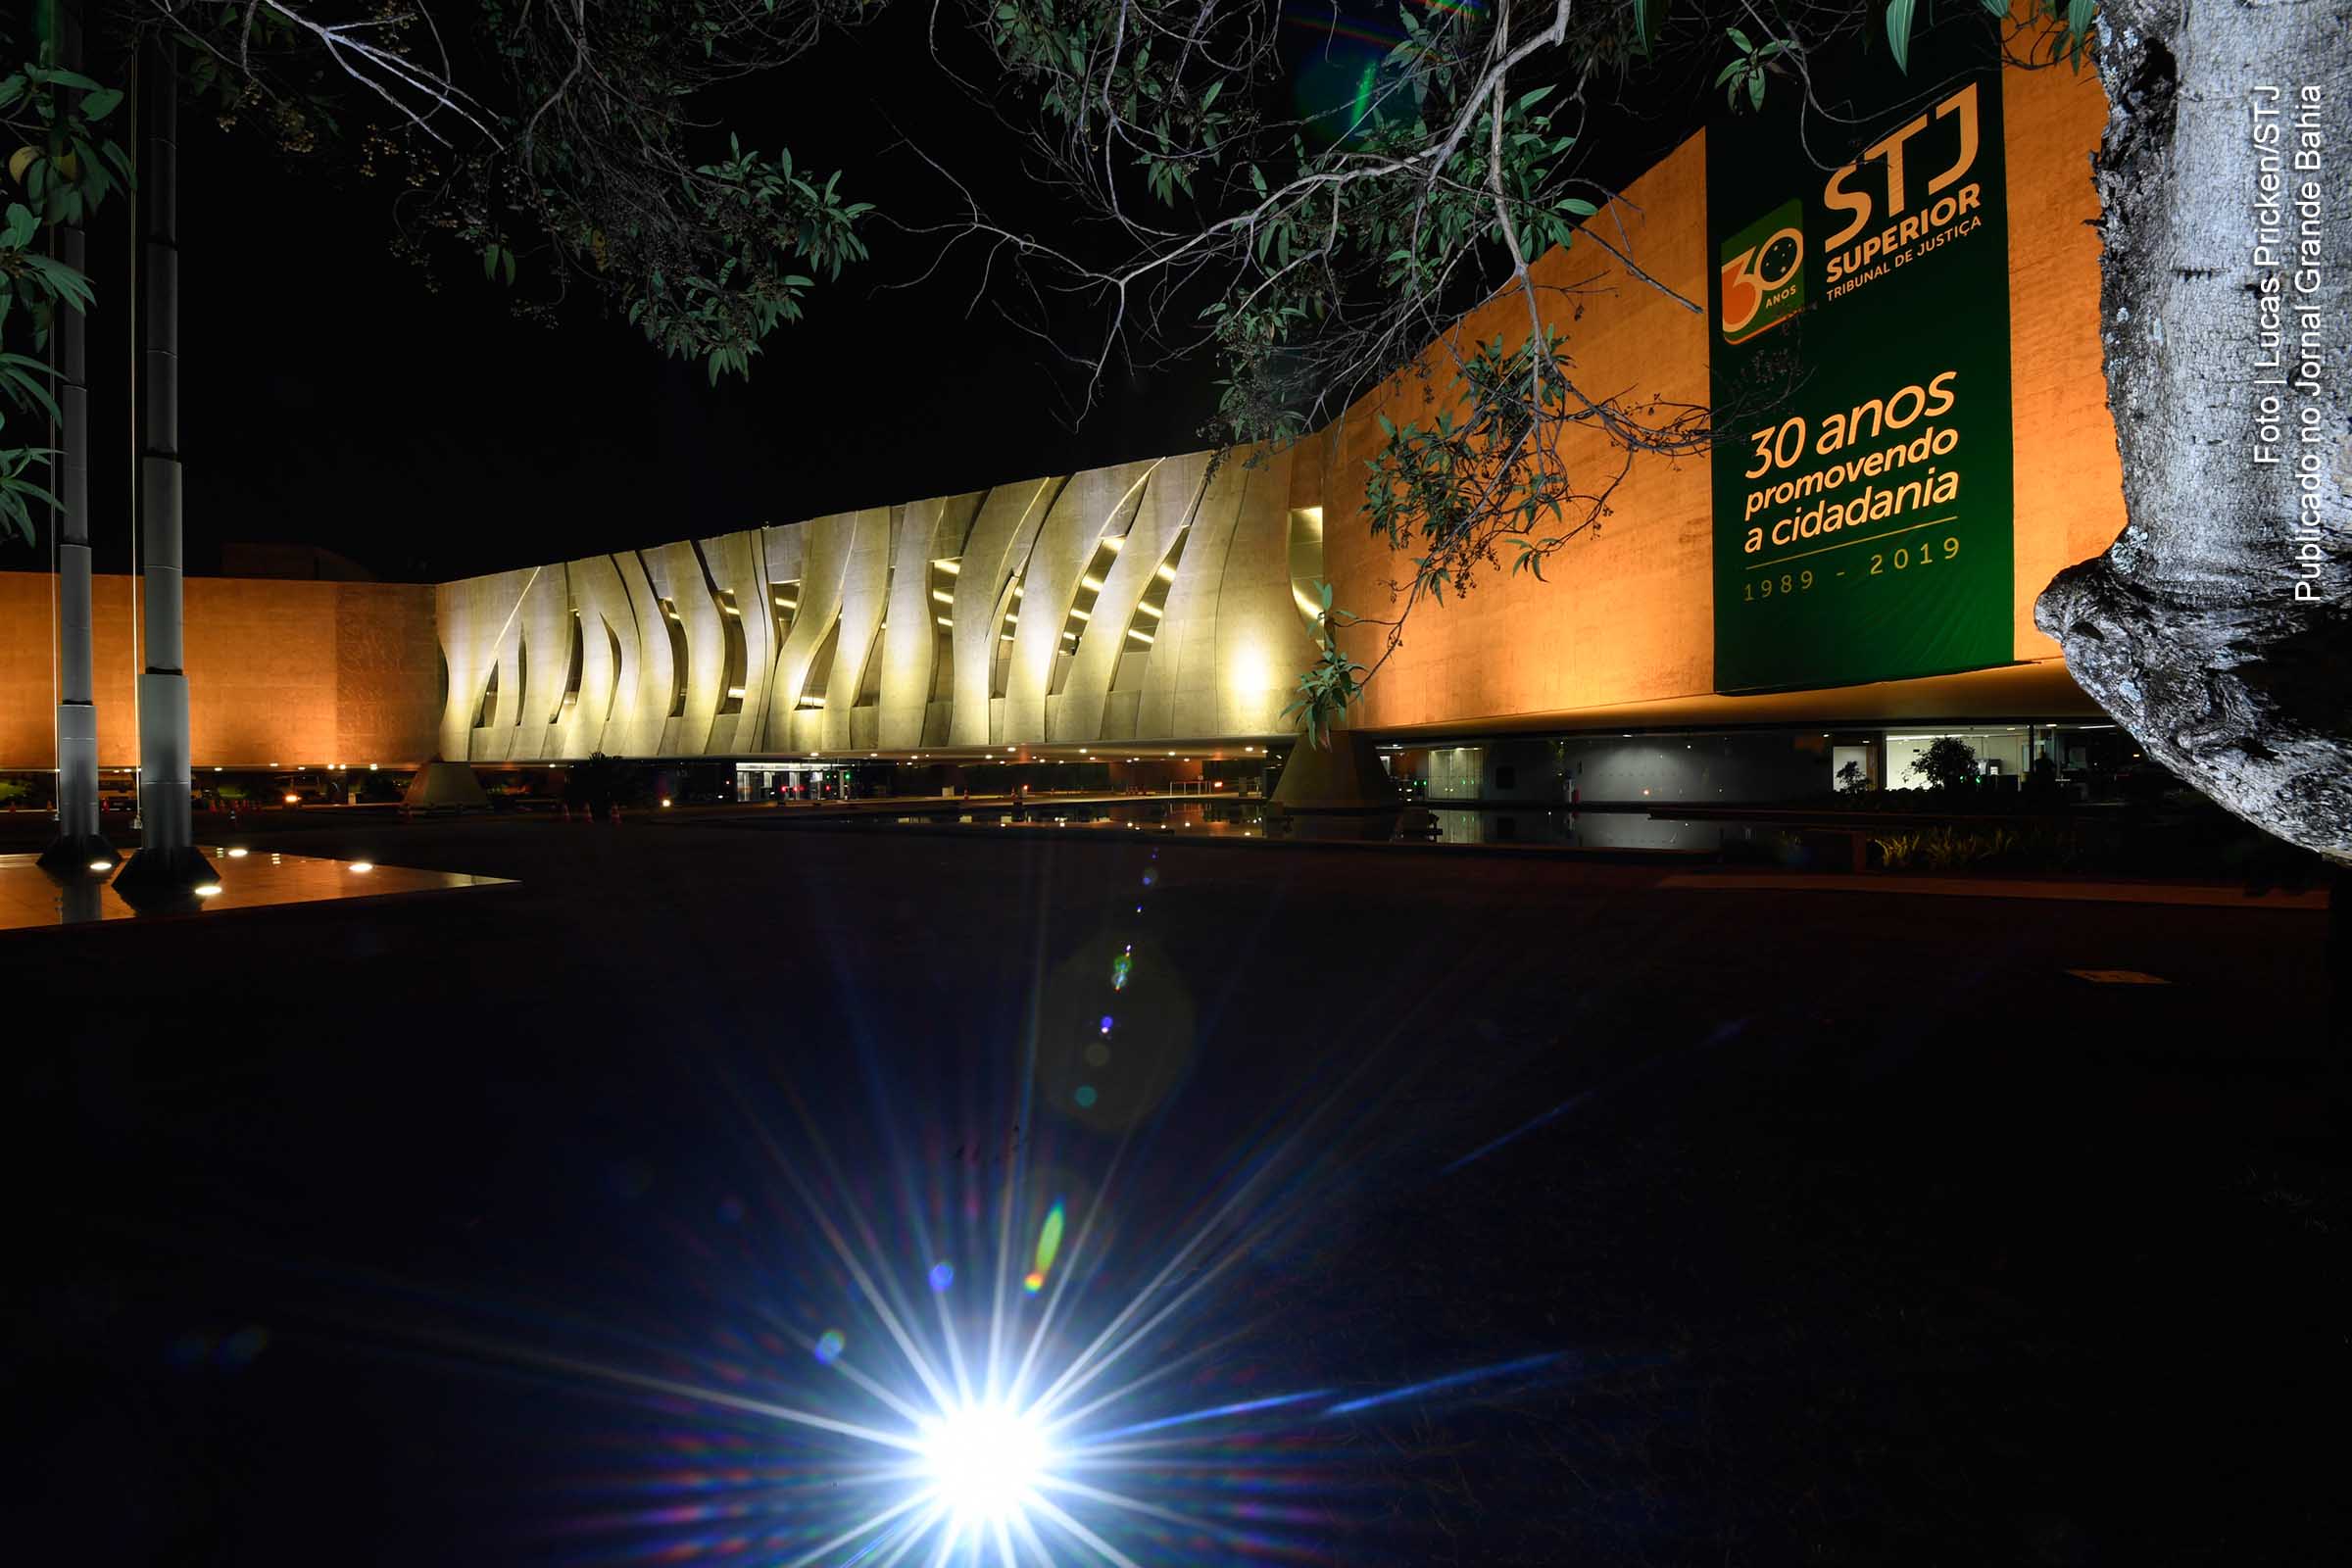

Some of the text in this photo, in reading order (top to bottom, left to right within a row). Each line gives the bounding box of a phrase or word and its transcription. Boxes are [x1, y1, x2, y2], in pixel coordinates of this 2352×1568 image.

[1824, 81, 1979, 253] STJ
[1721, 227, 1804, 333] 30
[1826, 182, 1982, 283] SUPERIOR
[1826, 215, 1983, 302] TRIBUNAL DE JUSTIÇA
[1765, 284, 1796, 309] ANOS
[1744, 370, 1957, 479] 30 anos
[1743, 466, 1959, 554] a cidadania
[1744, 426, 1959, 521] promovendo
[1743, 570, 1813, 602] 1989
[1870, 536, 1960, 575] 2019
